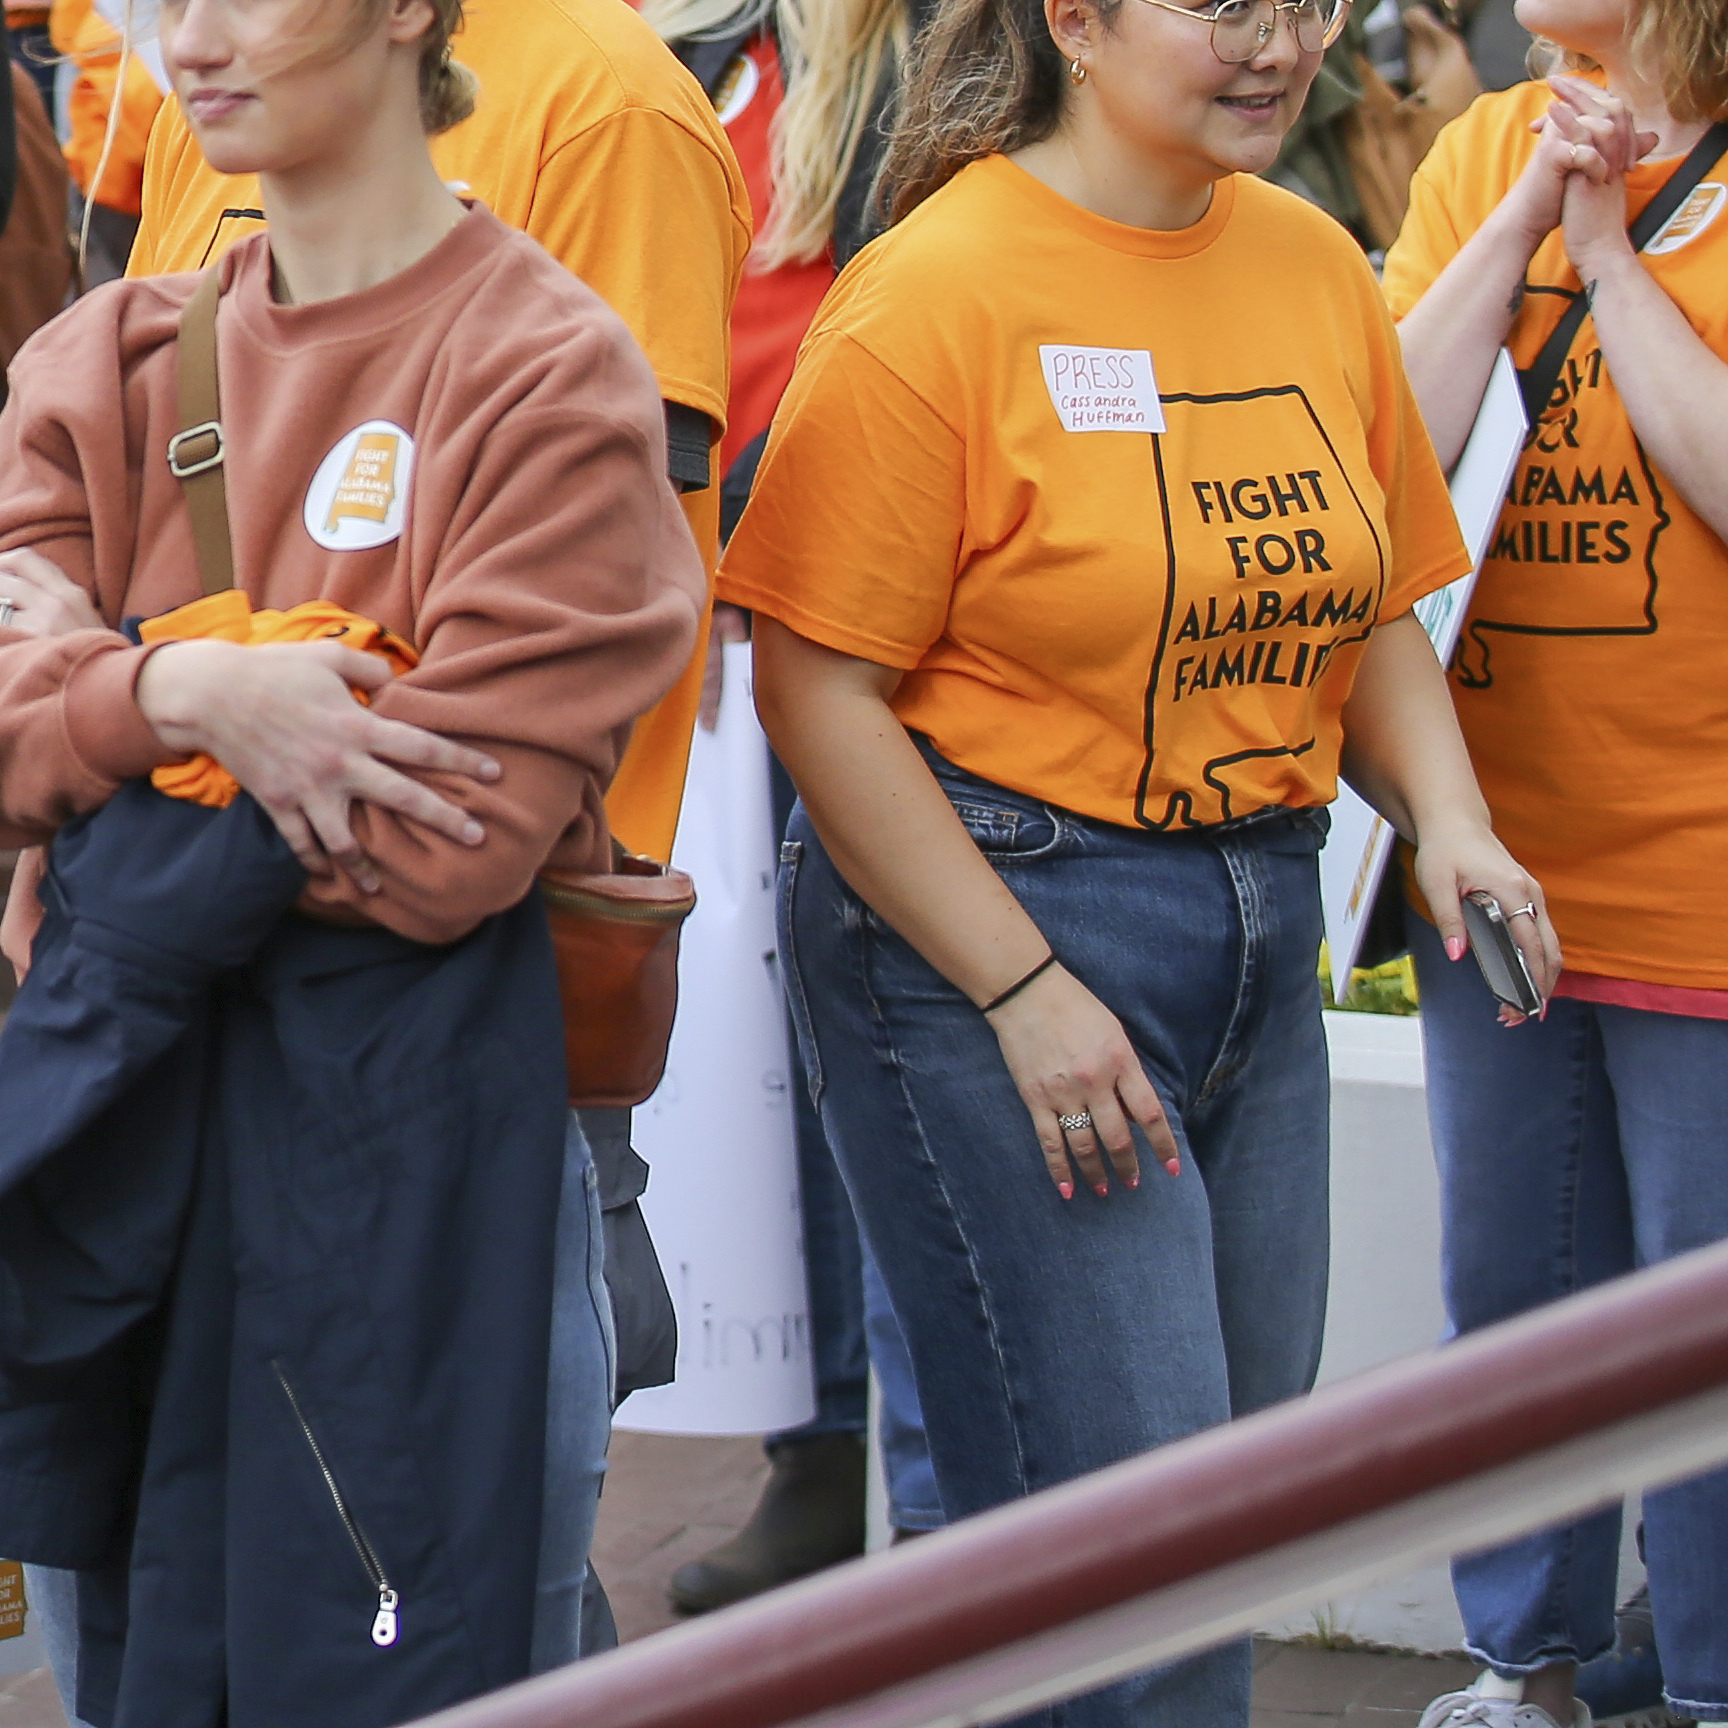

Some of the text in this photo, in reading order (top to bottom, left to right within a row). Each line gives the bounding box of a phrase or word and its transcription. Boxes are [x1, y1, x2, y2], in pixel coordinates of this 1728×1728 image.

[1053, 353, 1134, 391] PRESS
[1191, 470, 1329, 523] FIGHT
[1226, 529, 1333, 579] FOR
[1173, 587, 1372, 645] ALABAMA
